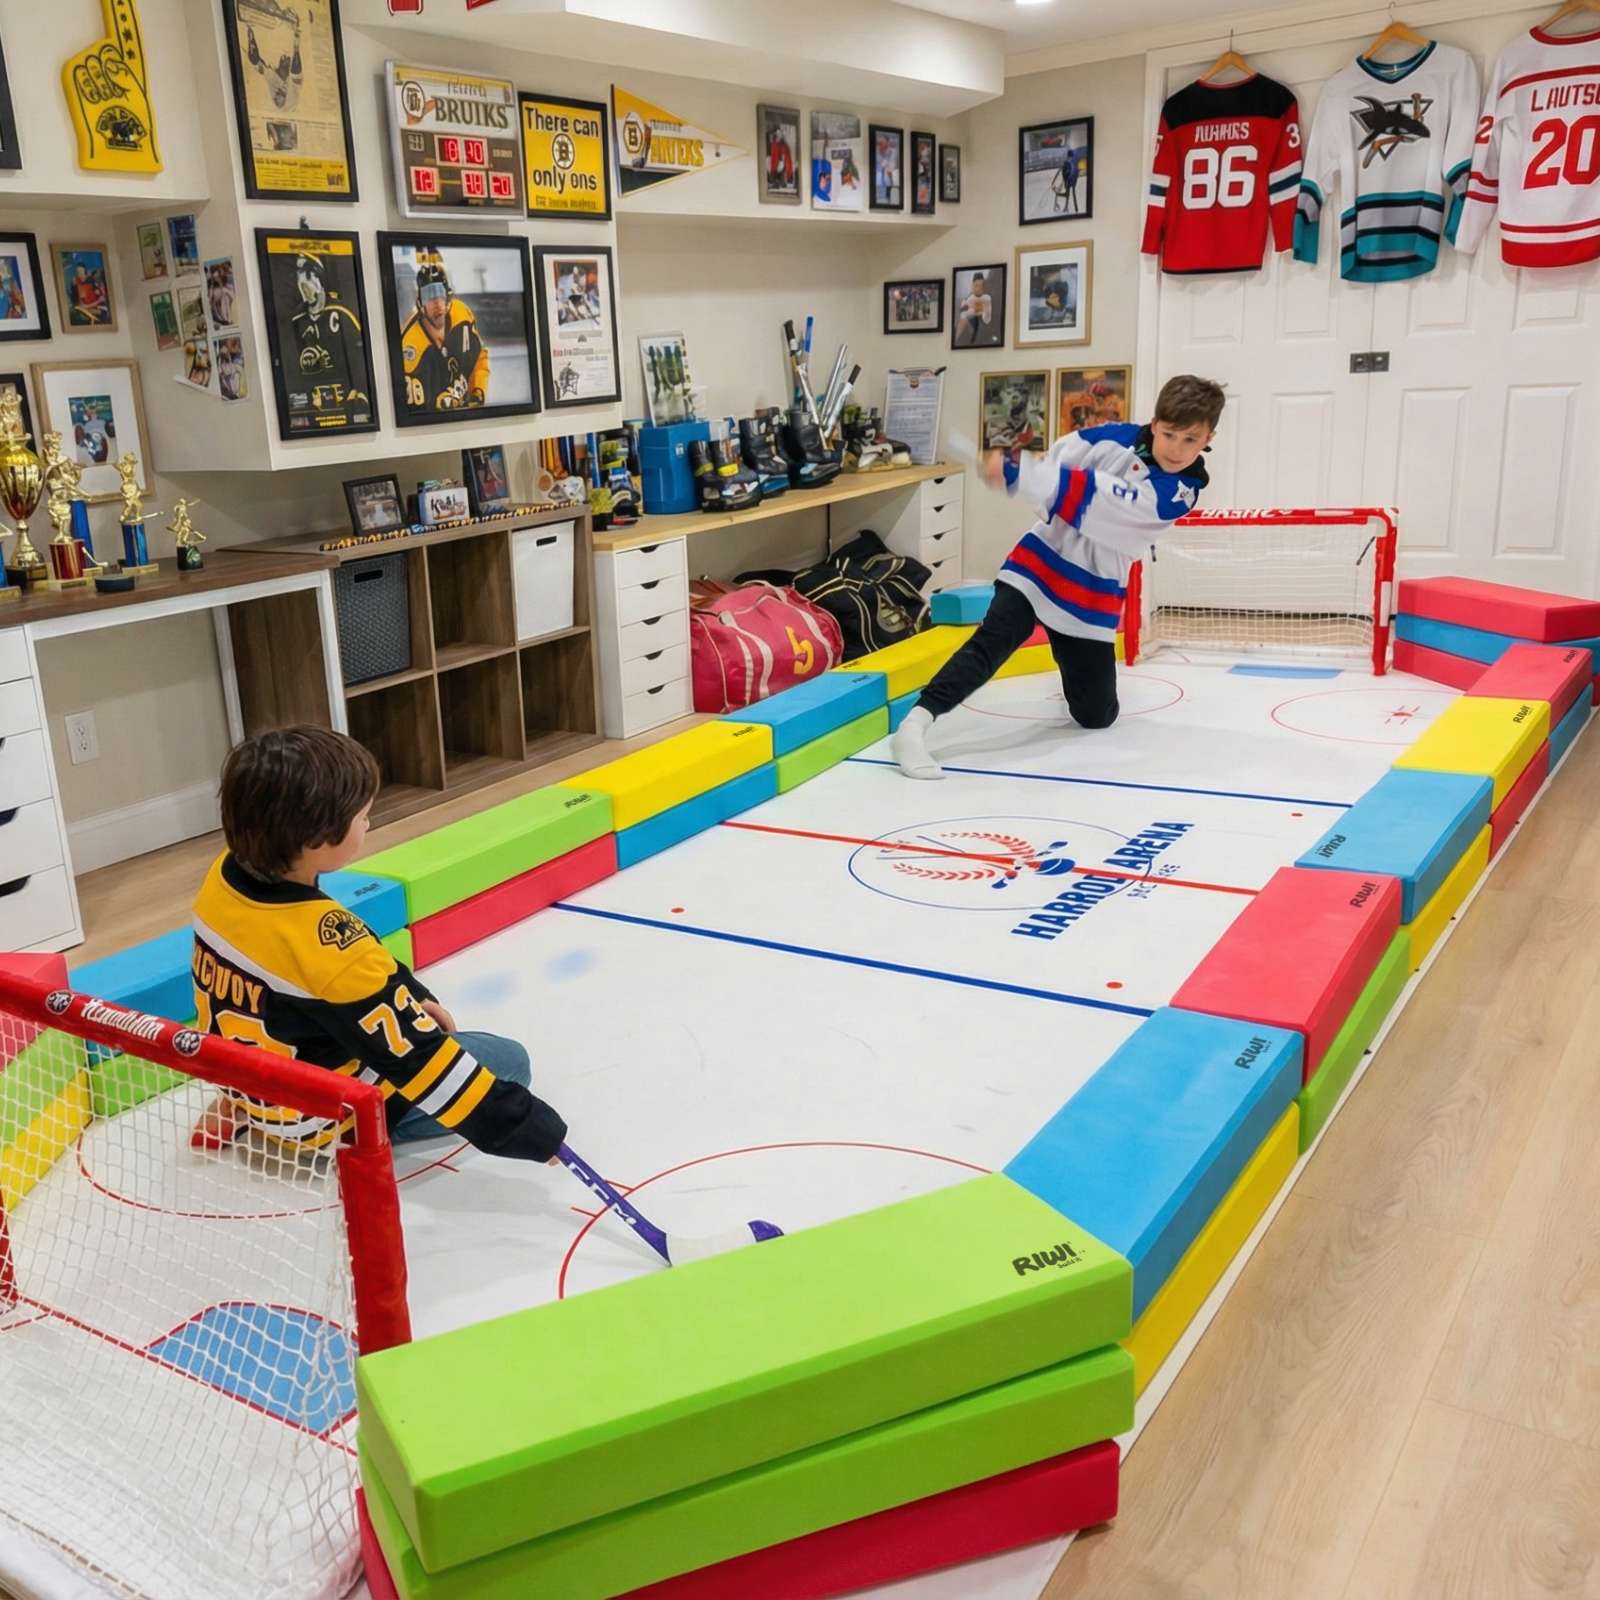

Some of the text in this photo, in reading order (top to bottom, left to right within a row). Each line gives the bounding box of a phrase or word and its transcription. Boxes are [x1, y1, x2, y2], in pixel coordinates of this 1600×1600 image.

[525, 106, 599, 138] There can
[1522, 114, 1600, 190] 20
[533, 166, 566, 194] only
[1182, 144, 1258, 210] 86
[1103, 821, 1195, 871] ARENA
[358, 984, 439, 1058] 73
[1234, 1036, 1268, 1070] RIWI
[1011, 1242, 1078, 1277] RIWI
